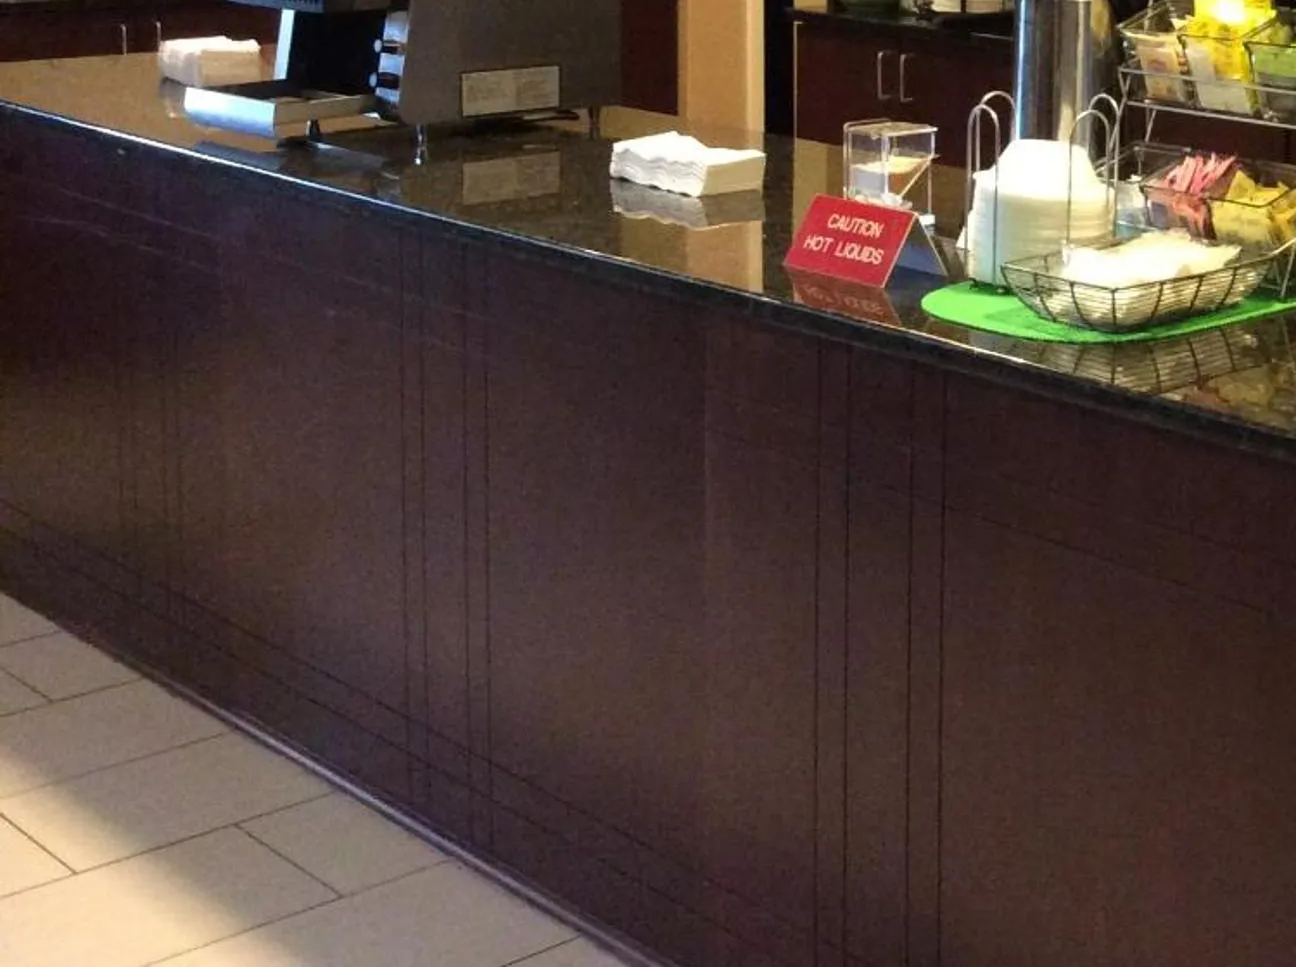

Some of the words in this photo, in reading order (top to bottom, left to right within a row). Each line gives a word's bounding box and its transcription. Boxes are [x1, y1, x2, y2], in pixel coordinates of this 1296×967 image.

[827, 213, 885, 238] CAUTION
[803, 234, 834, 252] HOT
[834, 240, 885, 265] LIQUIDS
